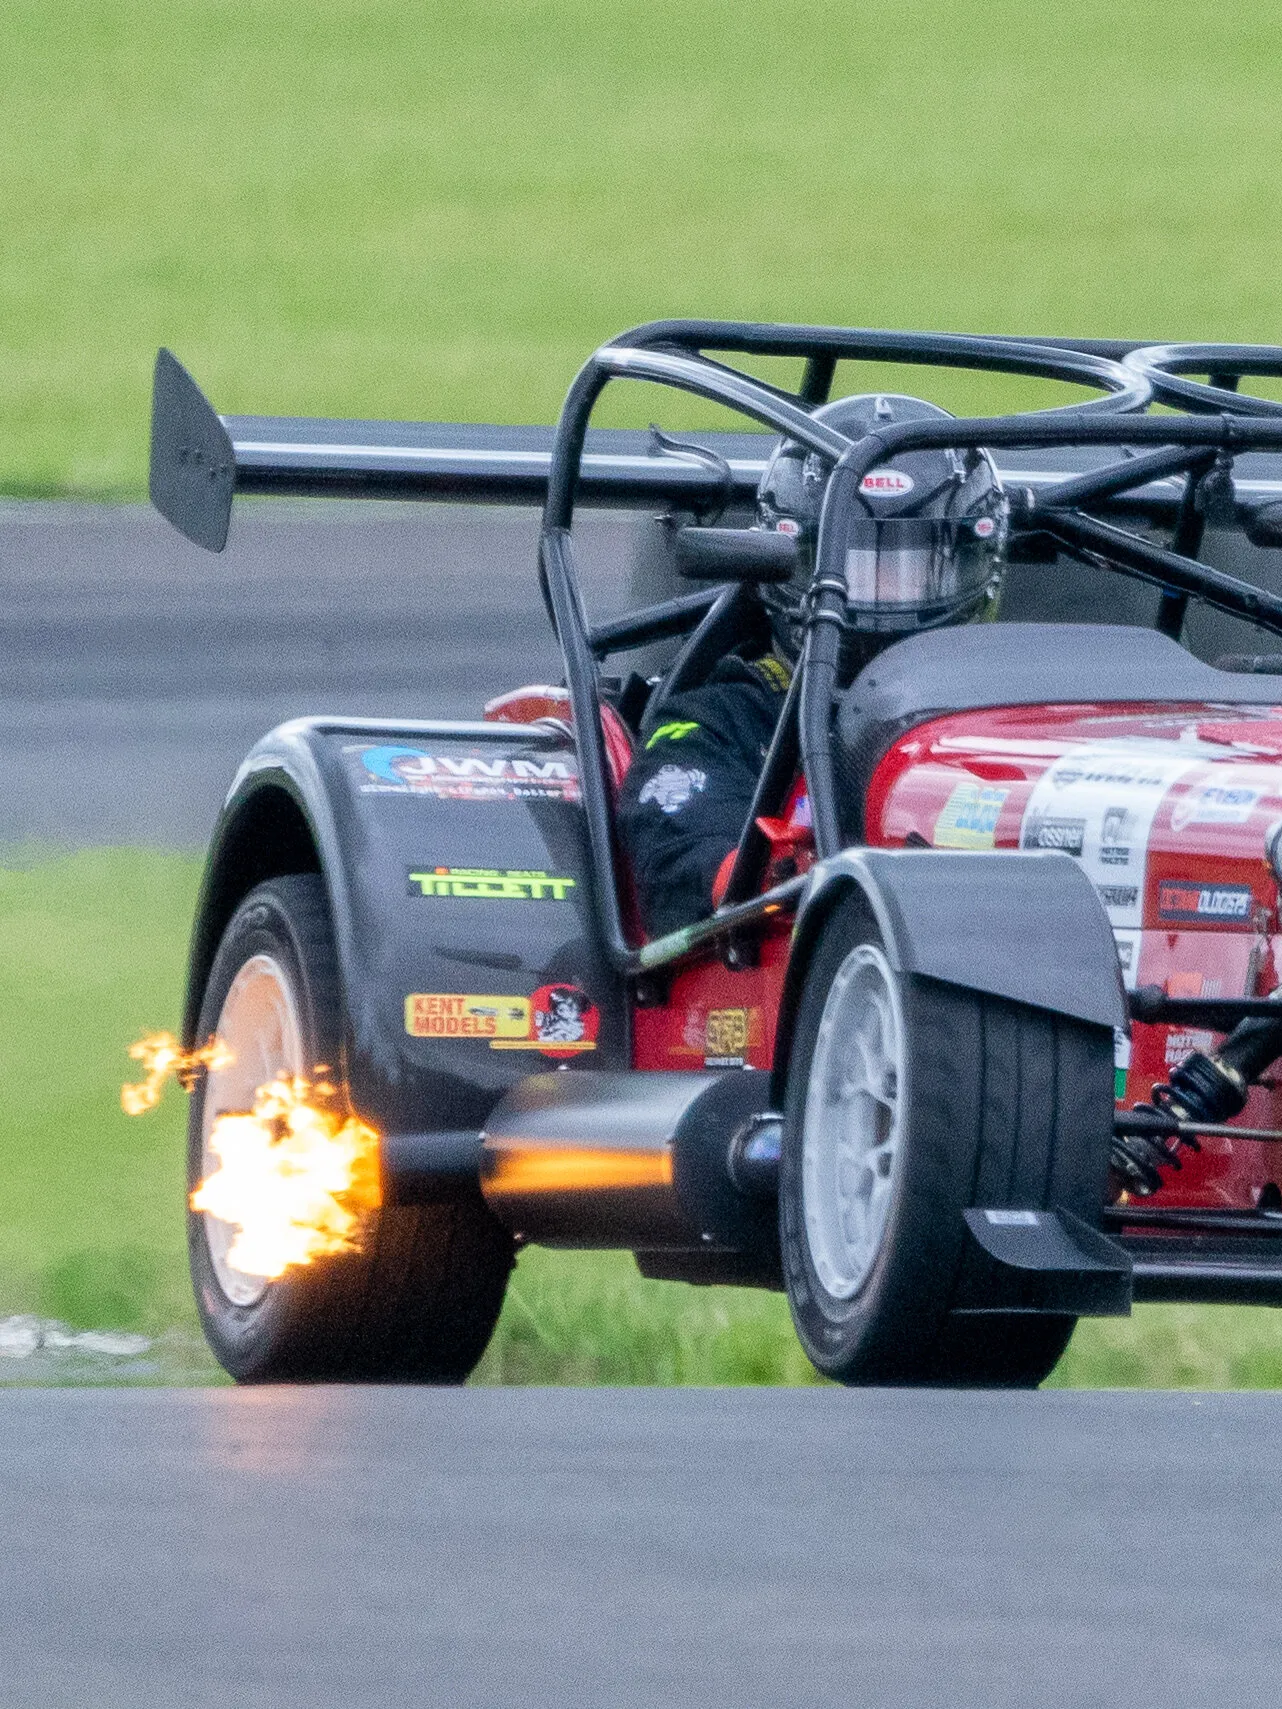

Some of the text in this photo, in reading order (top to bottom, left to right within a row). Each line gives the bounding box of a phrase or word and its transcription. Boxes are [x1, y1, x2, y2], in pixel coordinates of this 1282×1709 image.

[863, 476, 905, 489] BELL
[399, 755, 571, 780] JWM
[413, 997, 466, 1015] KENT
[413, 1016, 497, 1034] MODELS
